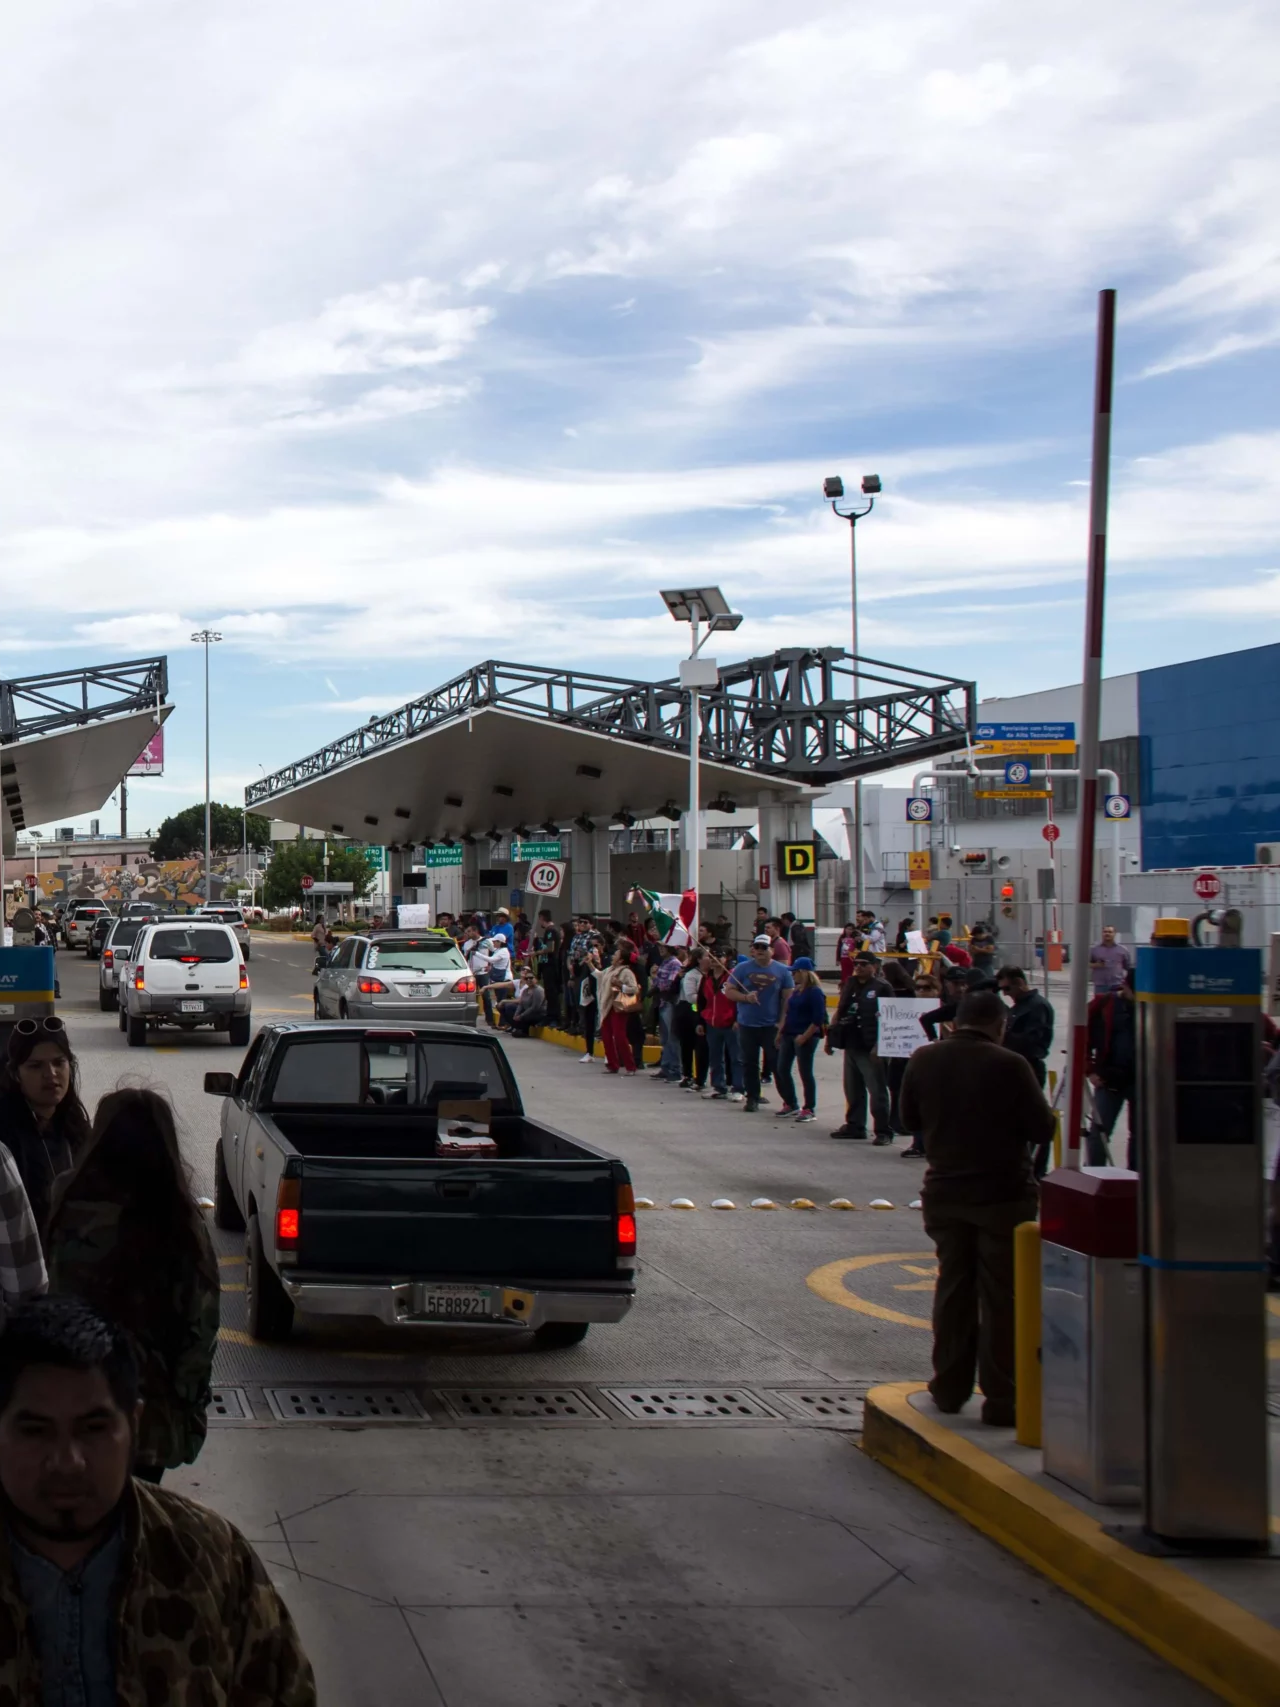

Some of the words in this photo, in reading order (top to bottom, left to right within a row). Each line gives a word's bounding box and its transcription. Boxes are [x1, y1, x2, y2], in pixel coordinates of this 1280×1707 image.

[789, 848, 810, 872] D
[538, 869, 554, 882] 10
[1196, 880, 1219, 892] ALTO
